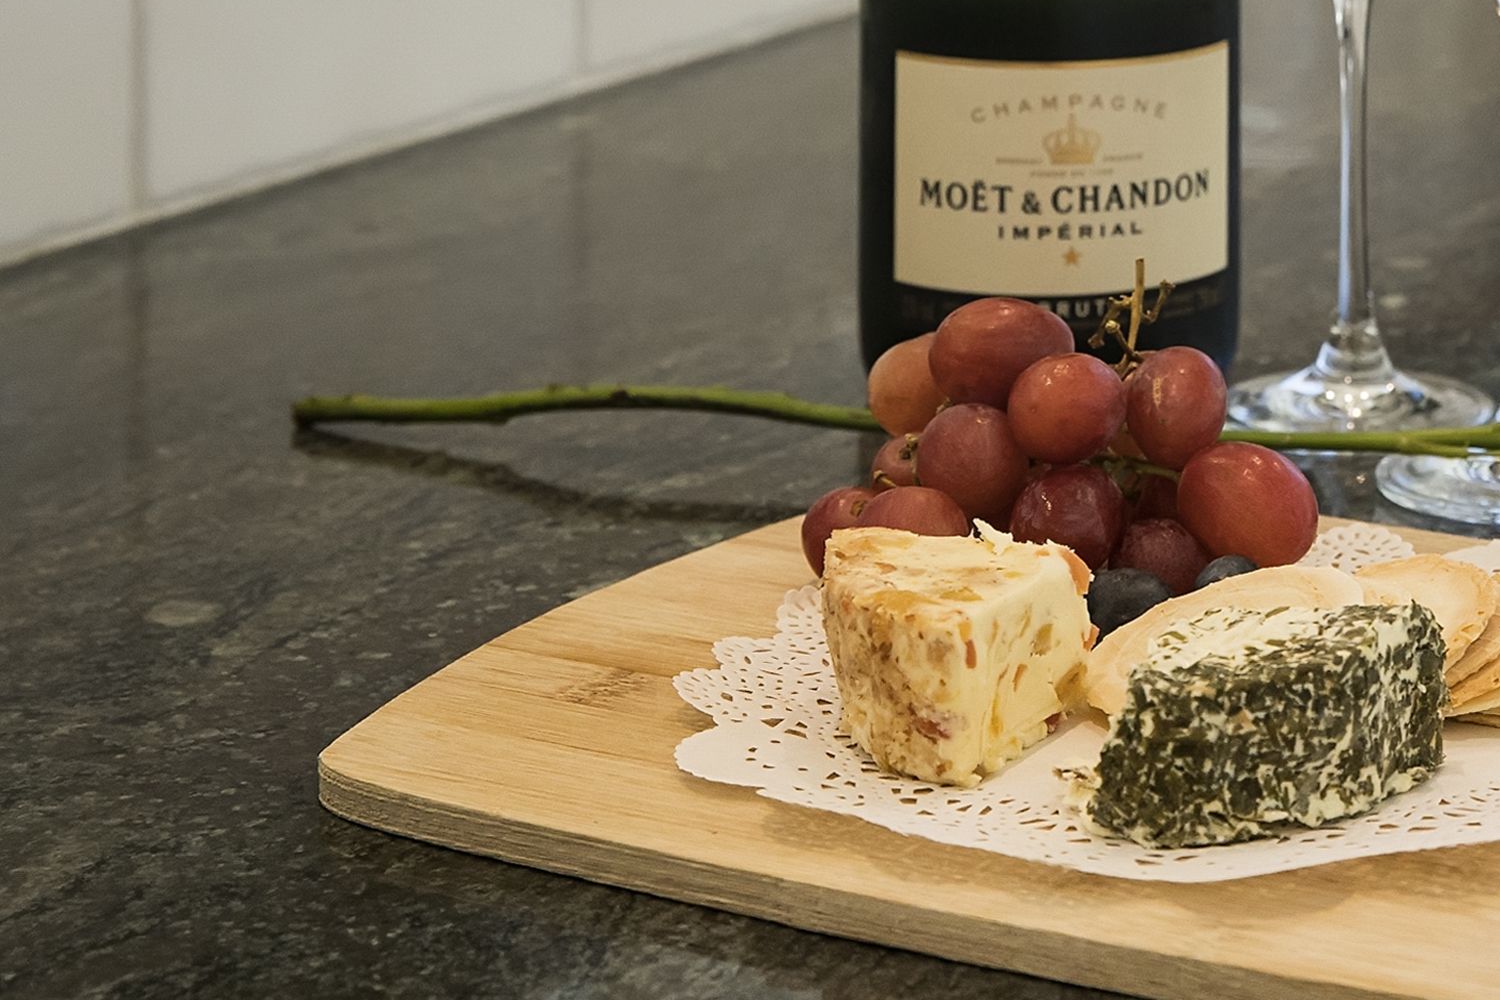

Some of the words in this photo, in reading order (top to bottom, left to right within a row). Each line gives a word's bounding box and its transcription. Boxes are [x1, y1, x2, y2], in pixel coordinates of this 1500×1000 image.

[971, 93, 1168, 125] CHAMPAGNE
[1021, 191, 1042, 215] &
[1050, 168, 1209, 214] CHANDON
[997, 221, 1144, 240] IMPÉRIAL
